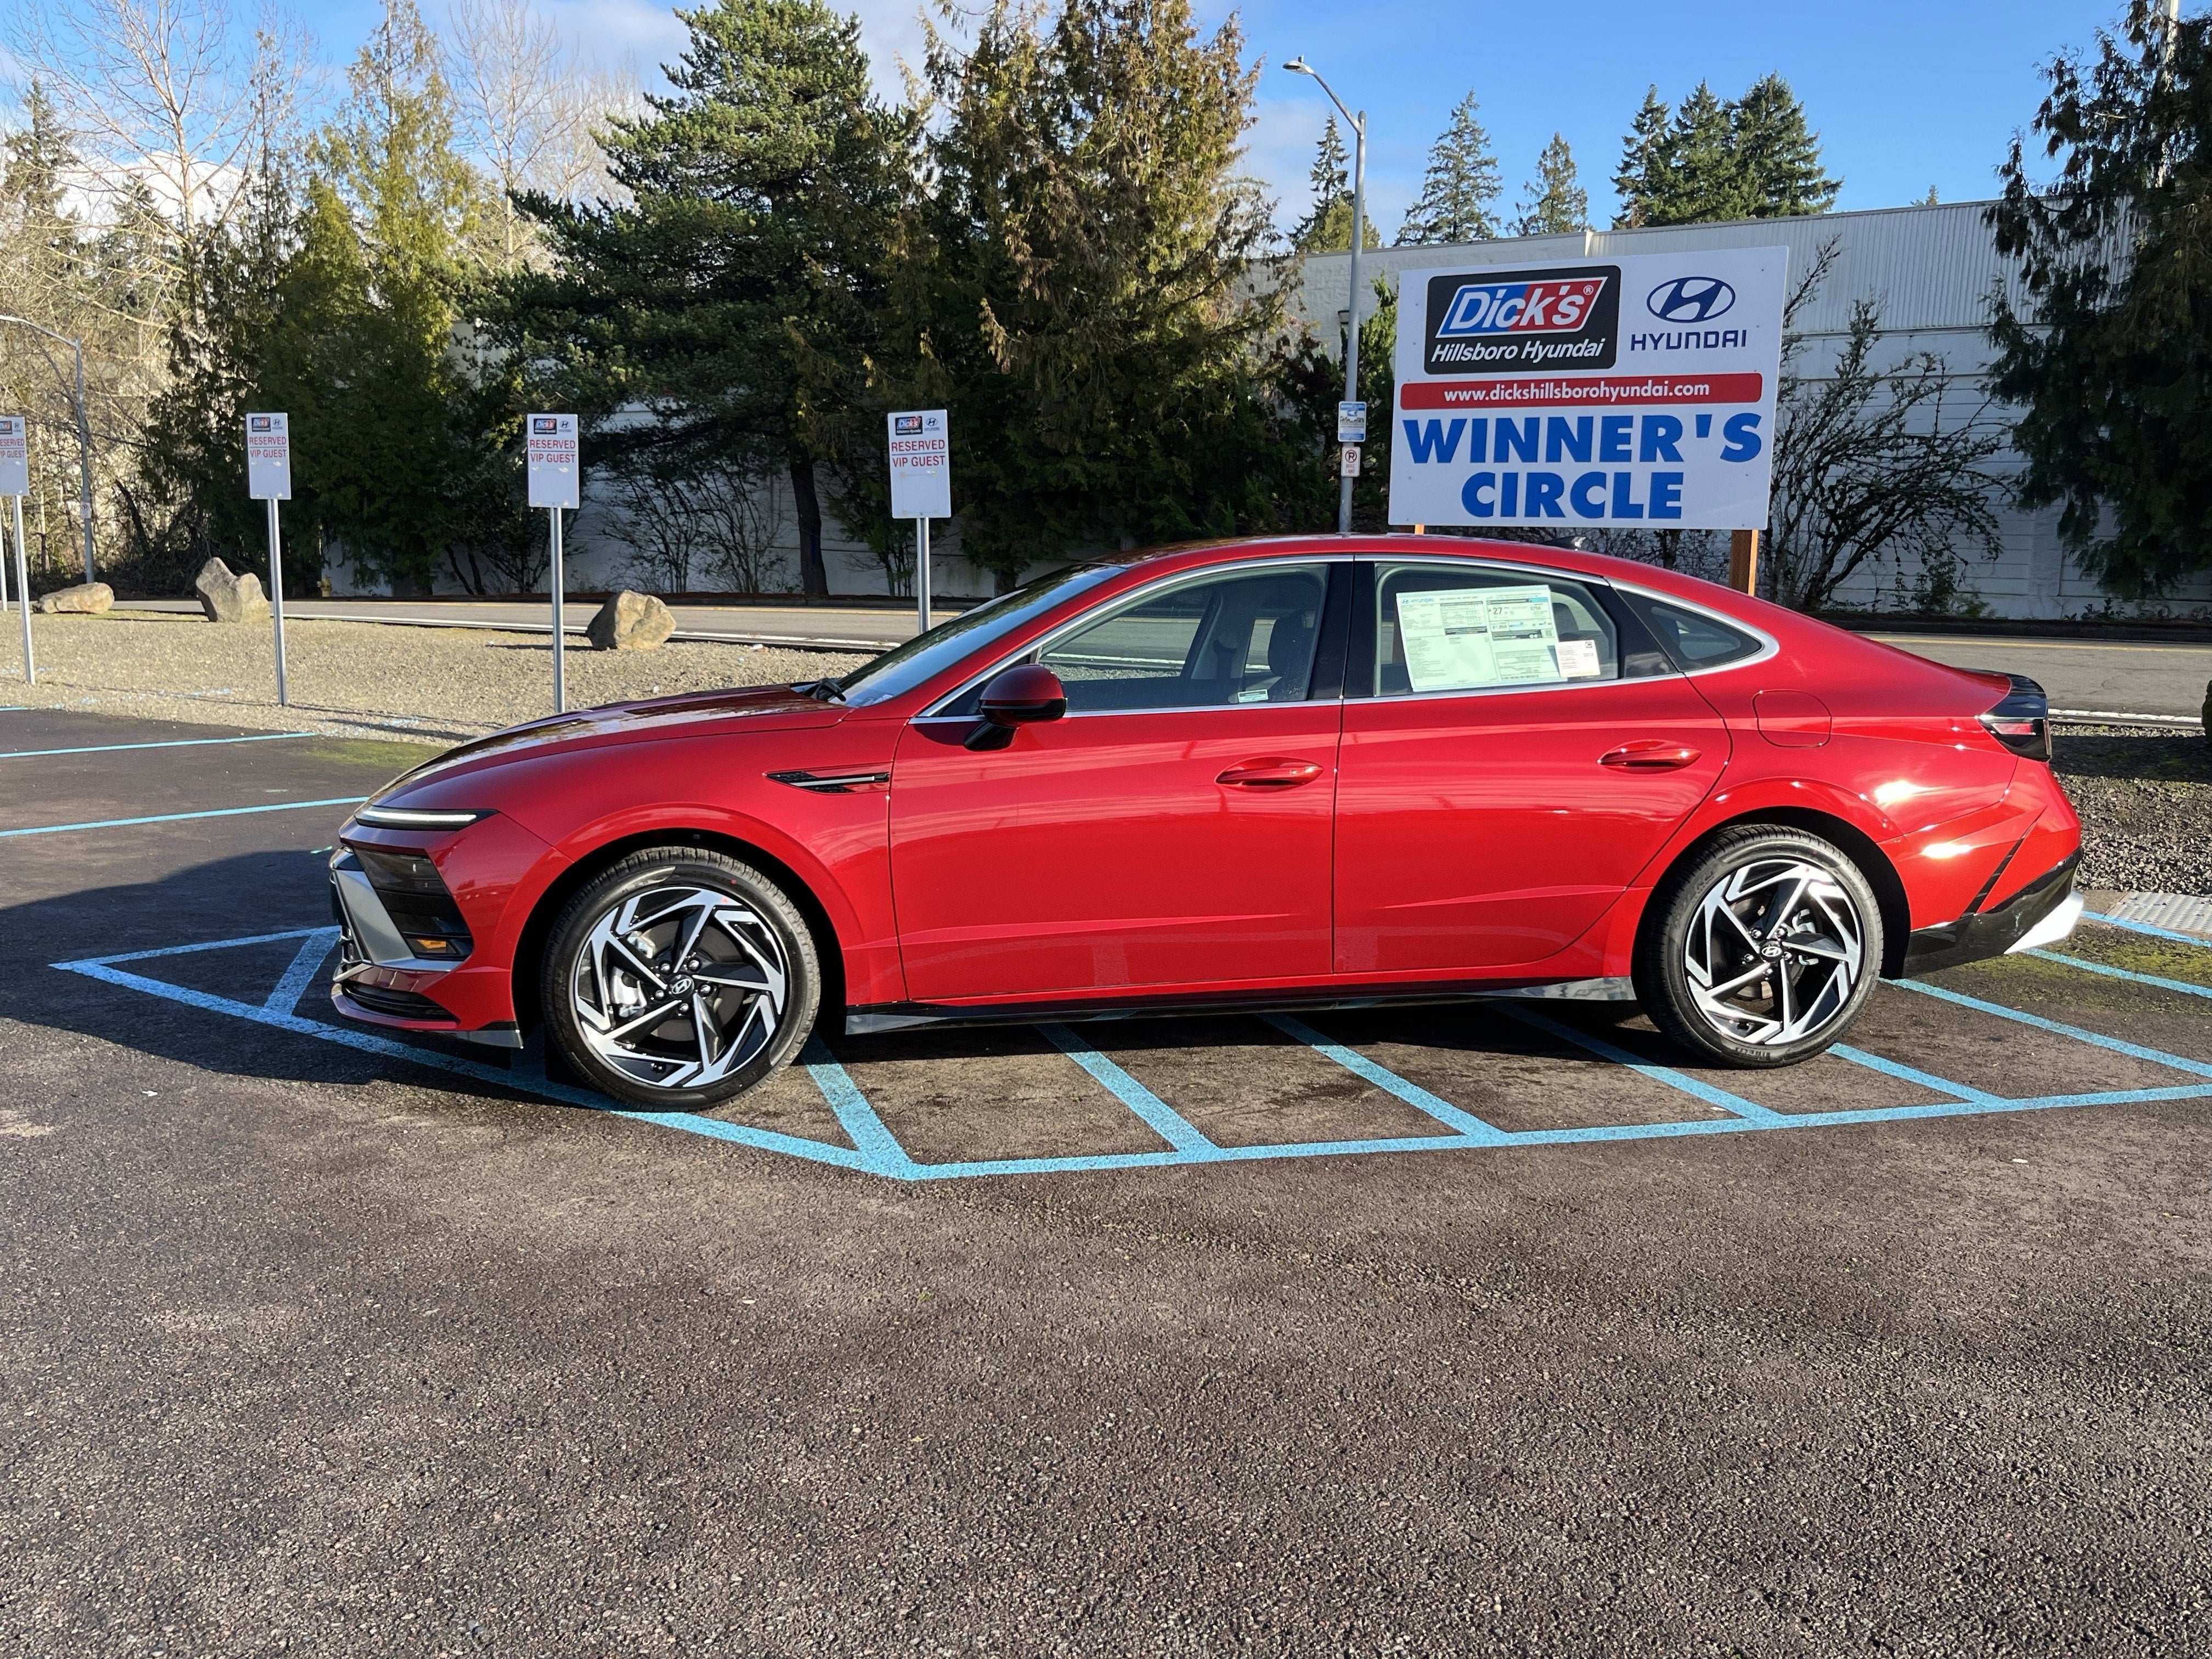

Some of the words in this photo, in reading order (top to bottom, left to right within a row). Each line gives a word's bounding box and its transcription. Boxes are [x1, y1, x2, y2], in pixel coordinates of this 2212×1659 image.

[1630, 330, 1747, 351] HYUNDAI
[1431, 342, 1519, 363] Hillsboro
[1520, 338, 1606, 364] Hyundai
[1444, 380, 1709, 402] www.dickshillsborohyundai.com
[0, 438, 25, 447] ESERVED
[249, 436, 286, 445] RESERVED
[530, 439, 575, 449] RESERVED
[1402, 413, 1763, 464] WINNER'S
[891, 439, 945, 452] RESERVED
[7, 450, 25, 458] GUEST
[250, 450, 261, 458] VIP
[263, 449, 286, 458] GUEST
[531, 453, 544, 462] VIP
[546, 453, 575, 463] GUEST
[893, 457, 908, 468] VIP
[911, 455, 945, 467] GUEST
[1461, 471, 1684, 520] CIRCLE
[1492, 607, 1503, 615] 27
